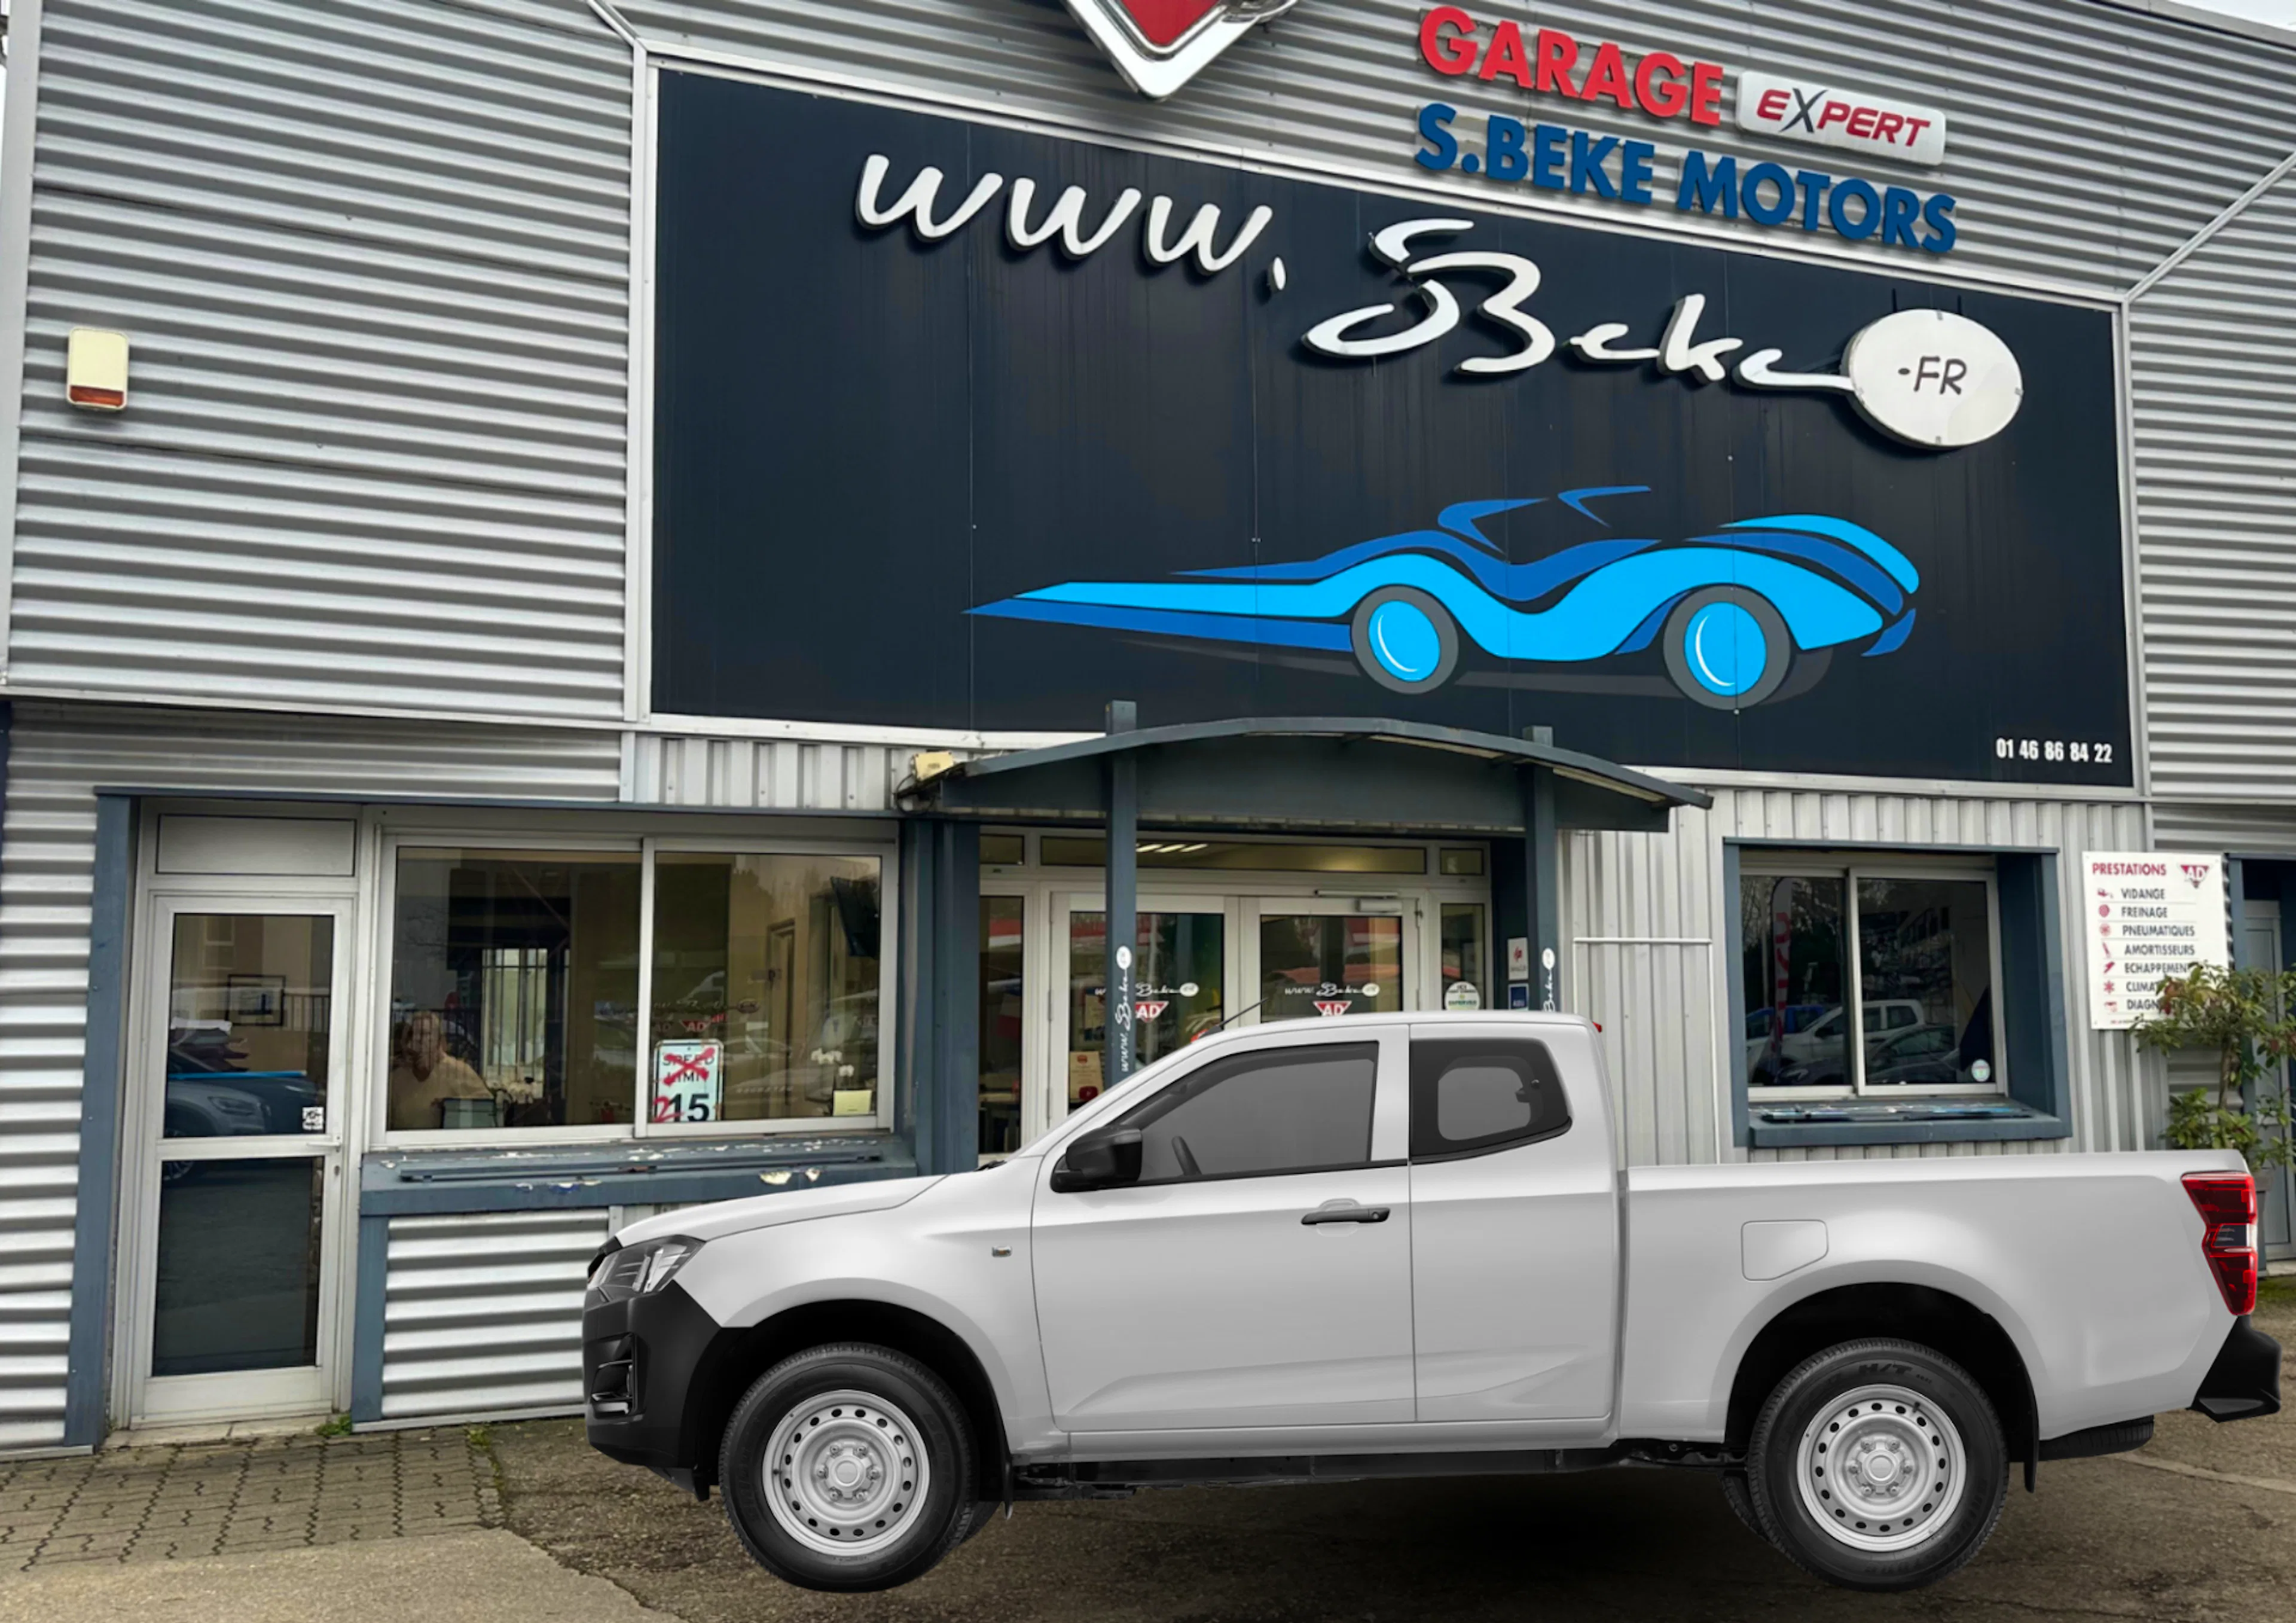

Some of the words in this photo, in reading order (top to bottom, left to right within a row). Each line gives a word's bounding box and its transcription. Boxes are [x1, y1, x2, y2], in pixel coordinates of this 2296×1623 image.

[1419, 5, 1723, 127] GARAGE
[1415, 103, 1655, 205] S.BEKE
[1677, 150, 1957, 254] MOTORS
[856, 154, 1287, 293] www.
[1995, 737, 2014, 759] 01
[2019, 739, 2039, 761] 46
[2044, 740, 2064, 761] 86
[2069, 742, 2089, 762] 84
[2094, 743, 2112, 763] 22
[2092, 862, 2167, 876] PRESTATIONS
[2185, 866, 2206, 882] AD
[2121, 888, 2166, 900] VIDANGE
[2121, 907, 2169, 918] FREINAGE
[2122, 925, 2196, 937] PNEUMATIQUES
[2124, 944, 2196, 956] AMORTISSEURS
[2124, 962, 2188, 974] ECHAPPEMEN
[1321, 1003, 1344, 1017] AD
[2127, 998, 2160, 1009] DIAGN
[1136, 1005, 1162, 1018] AD
